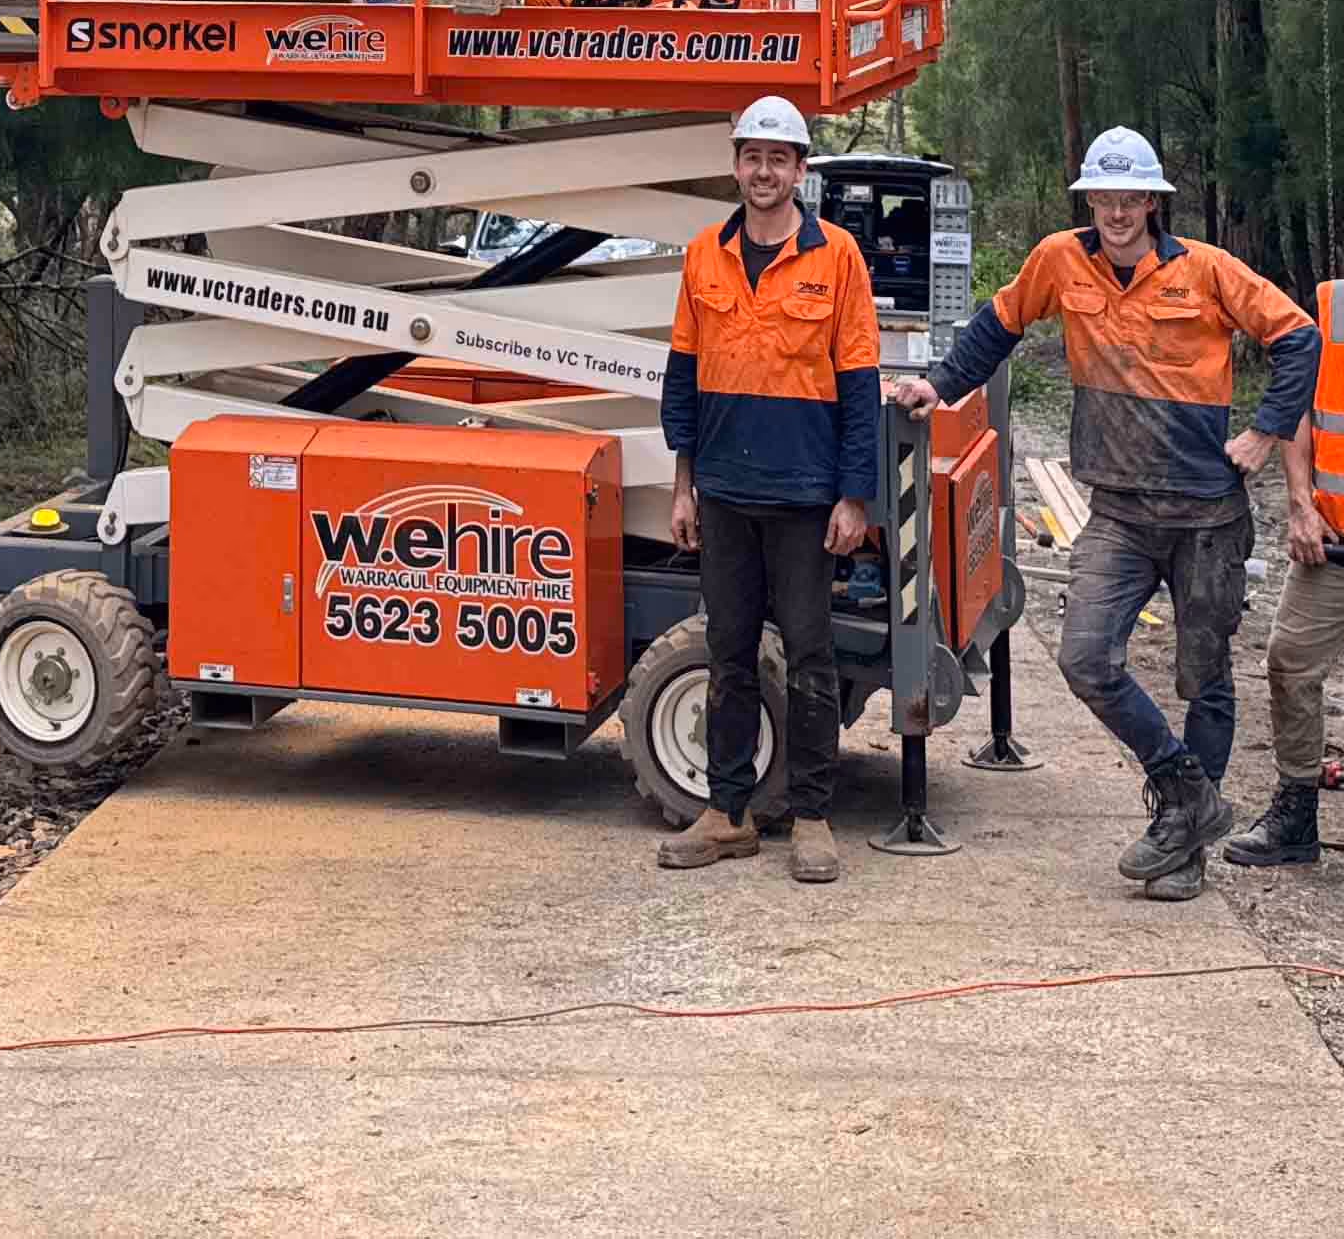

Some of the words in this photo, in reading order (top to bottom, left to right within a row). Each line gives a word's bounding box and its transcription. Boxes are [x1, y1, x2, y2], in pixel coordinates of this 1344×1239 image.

[98, 20, 236, 52] snorkel
[448, 26, 801, 62] www.vctraders.com.au
[455, 330, 532, 359] Subscribe
[536, 347, 552, 361] to
[557, 349, 579, 366] VC
[584, 355, 642, 379] Traders
[340, 568, 431, 590] WARRAGUL
[435, 575, 530, 598] EQUIPMENT
[534, 582, 572, 601] HIRE
[326, 594, 440, 643] 5623
[457, 604, 576, 655] 5005
